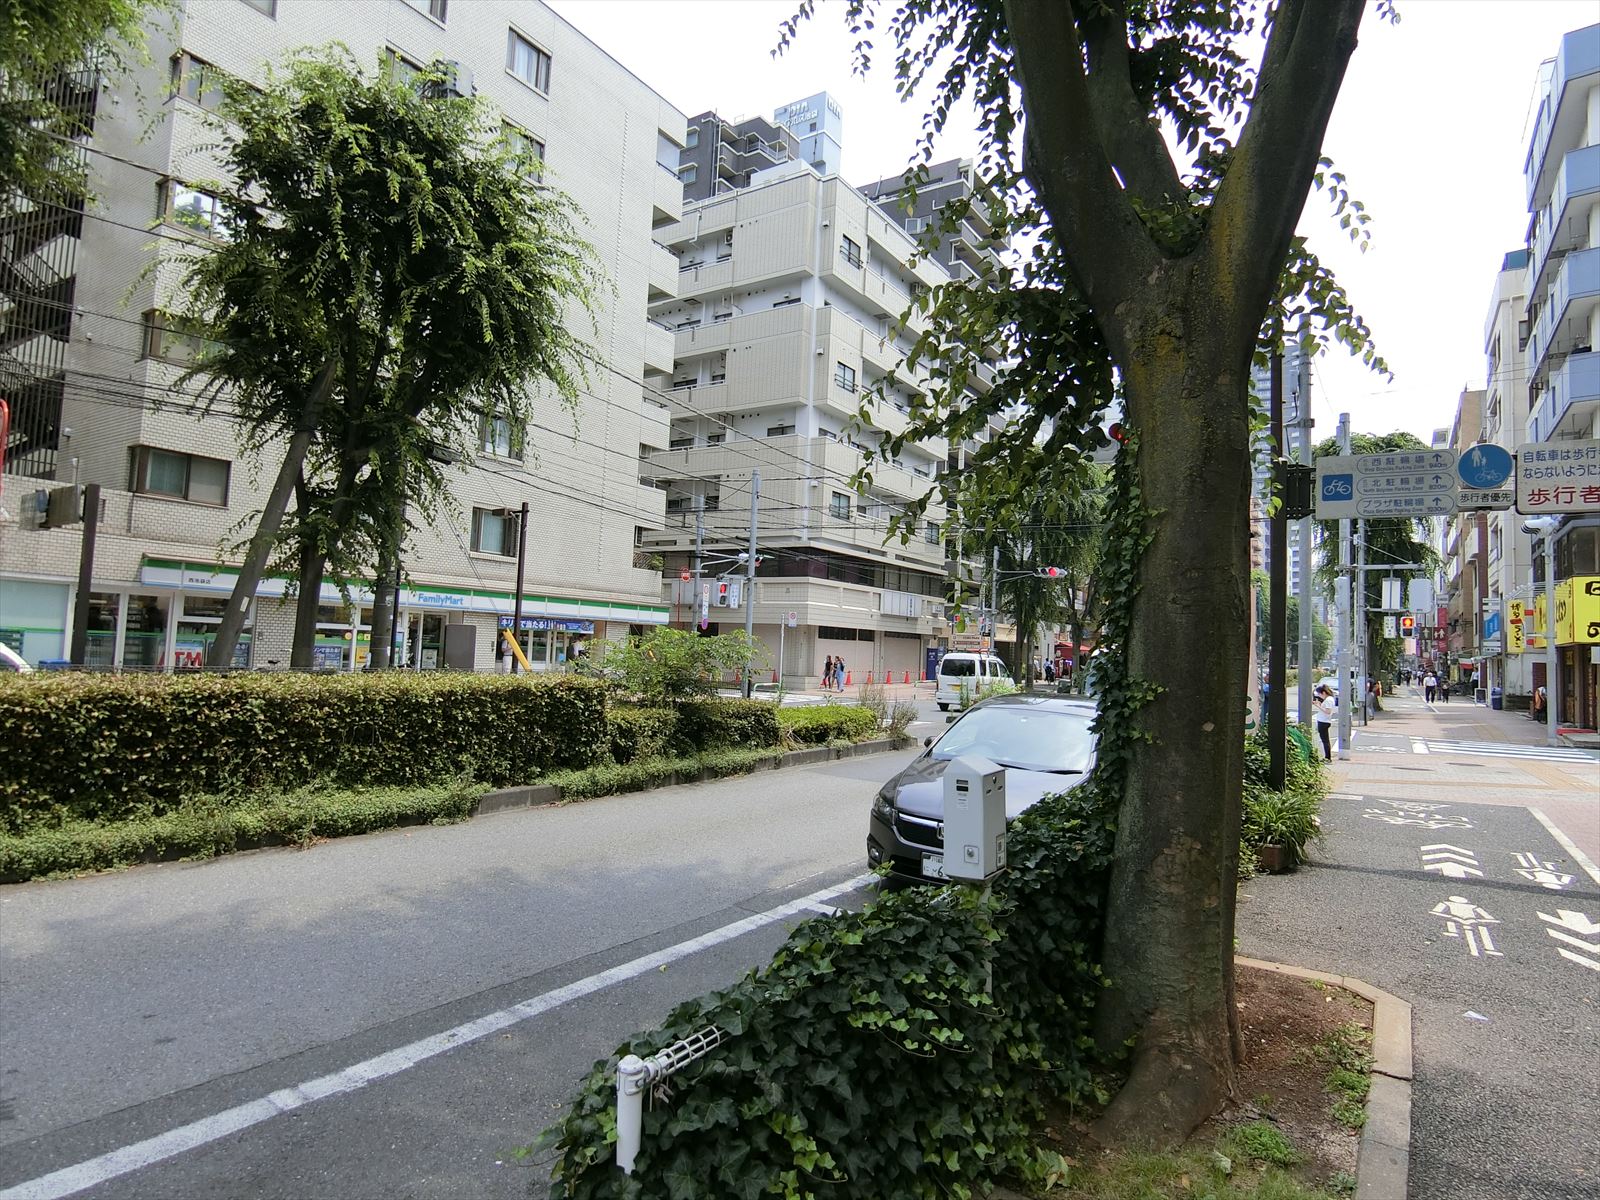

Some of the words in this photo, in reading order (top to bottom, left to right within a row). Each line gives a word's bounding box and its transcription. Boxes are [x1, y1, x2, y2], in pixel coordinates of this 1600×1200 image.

[1523, 446, 1600, 463] 自転車は歩行
[1523, 464, 1600, 479] ならないように
[1460, 492, 1511, 503] 歩行者優先
[417, 592, 465, 606] FamilyMart
[500, 618, 548, 630] キリで当たる!
